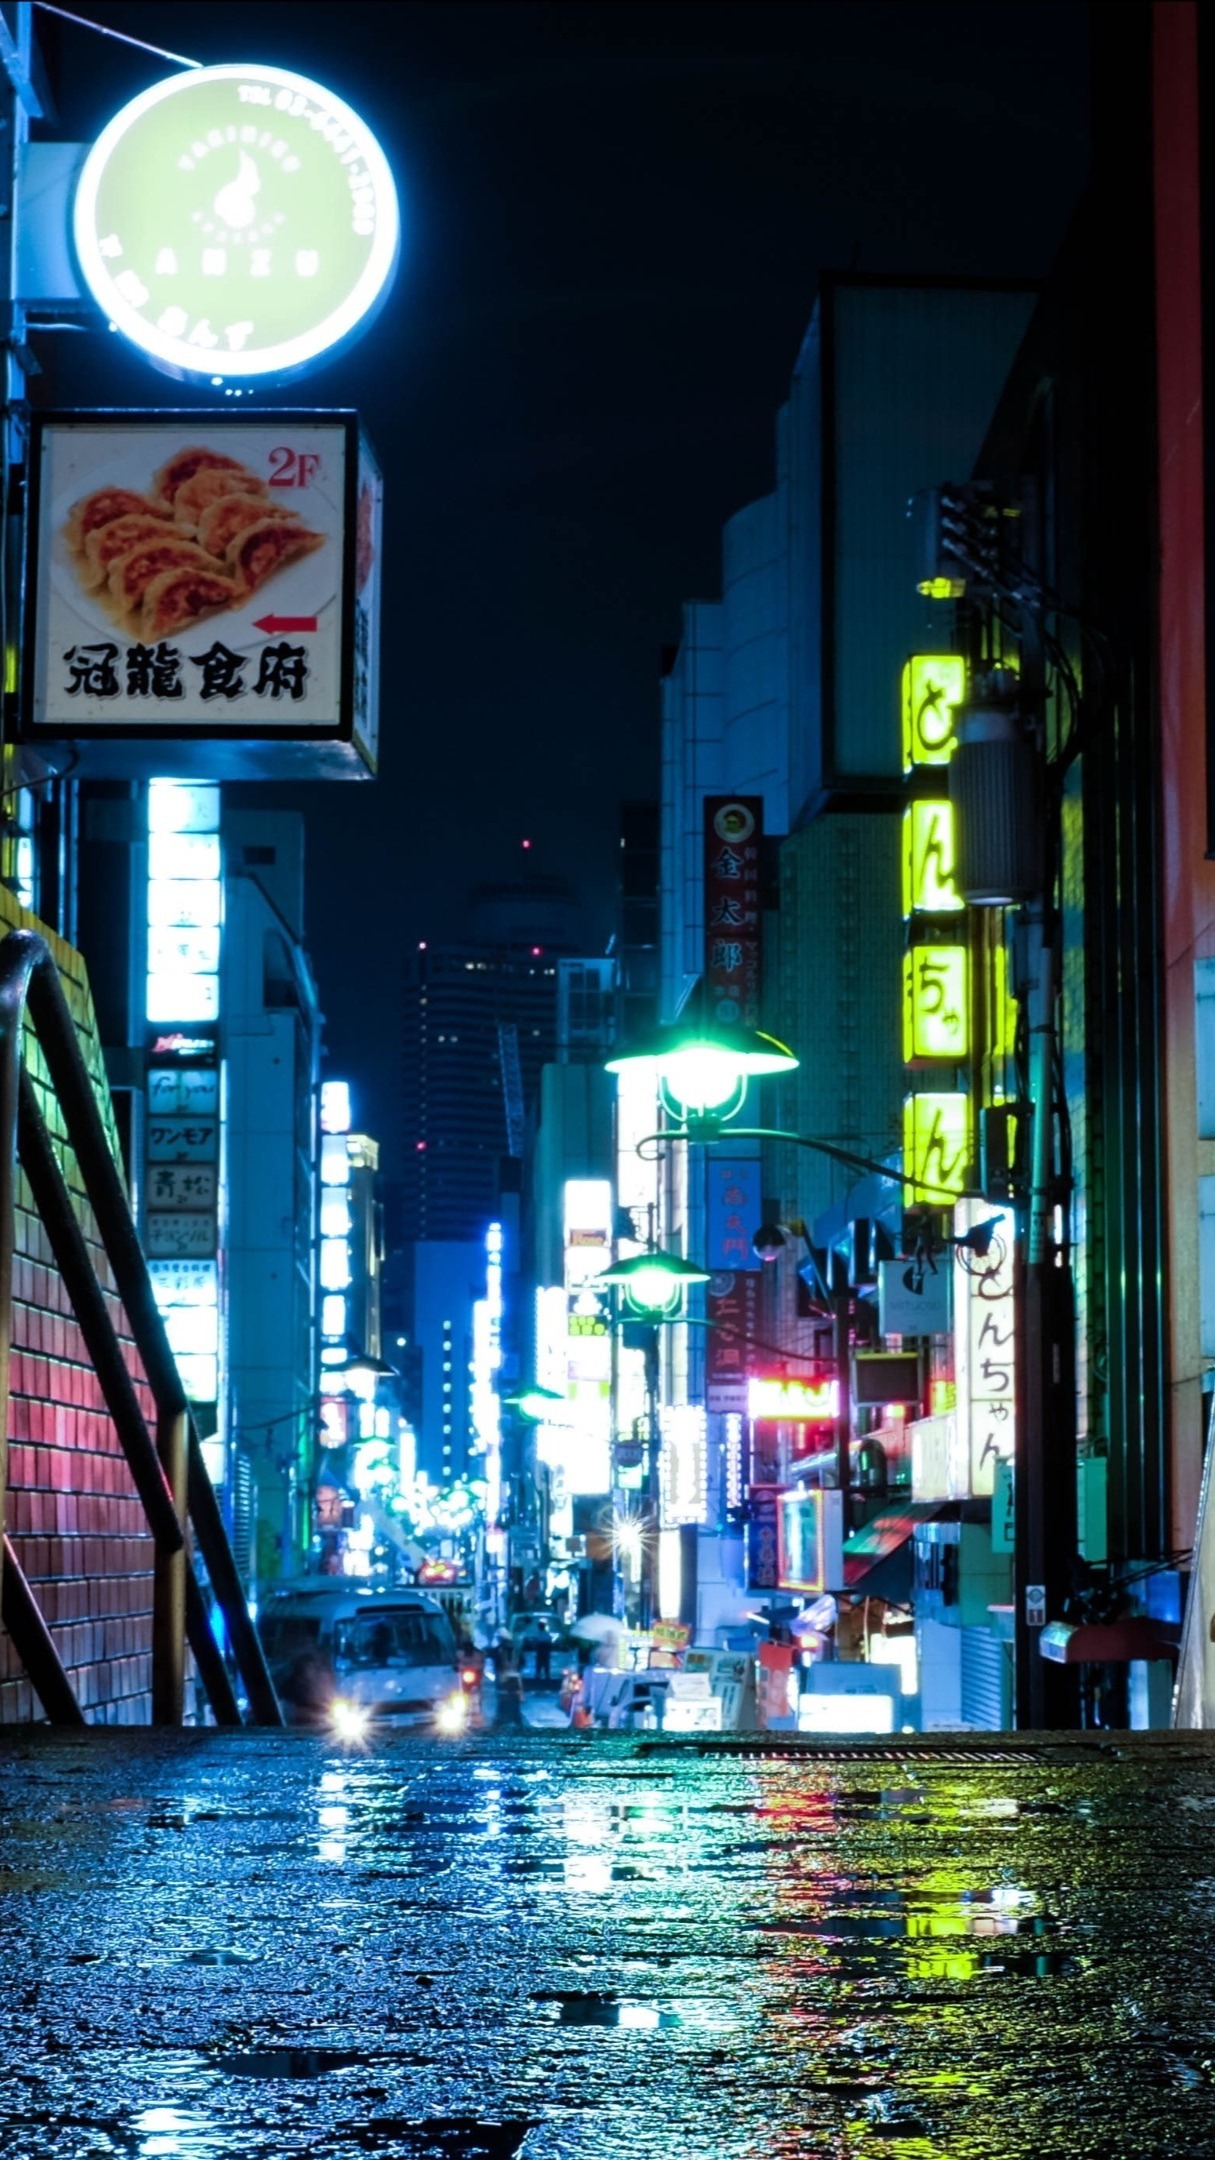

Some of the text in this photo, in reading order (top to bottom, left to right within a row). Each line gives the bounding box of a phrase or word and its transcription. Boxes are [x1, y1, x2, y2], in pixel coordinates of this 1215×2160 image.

[267, 445, 321, 488] 2F
[62, 640, 311, 702] 冠龍食府
[711, 845, 744, 974] 金太郎
[150, 1127, 214, 1146] ワンモア
